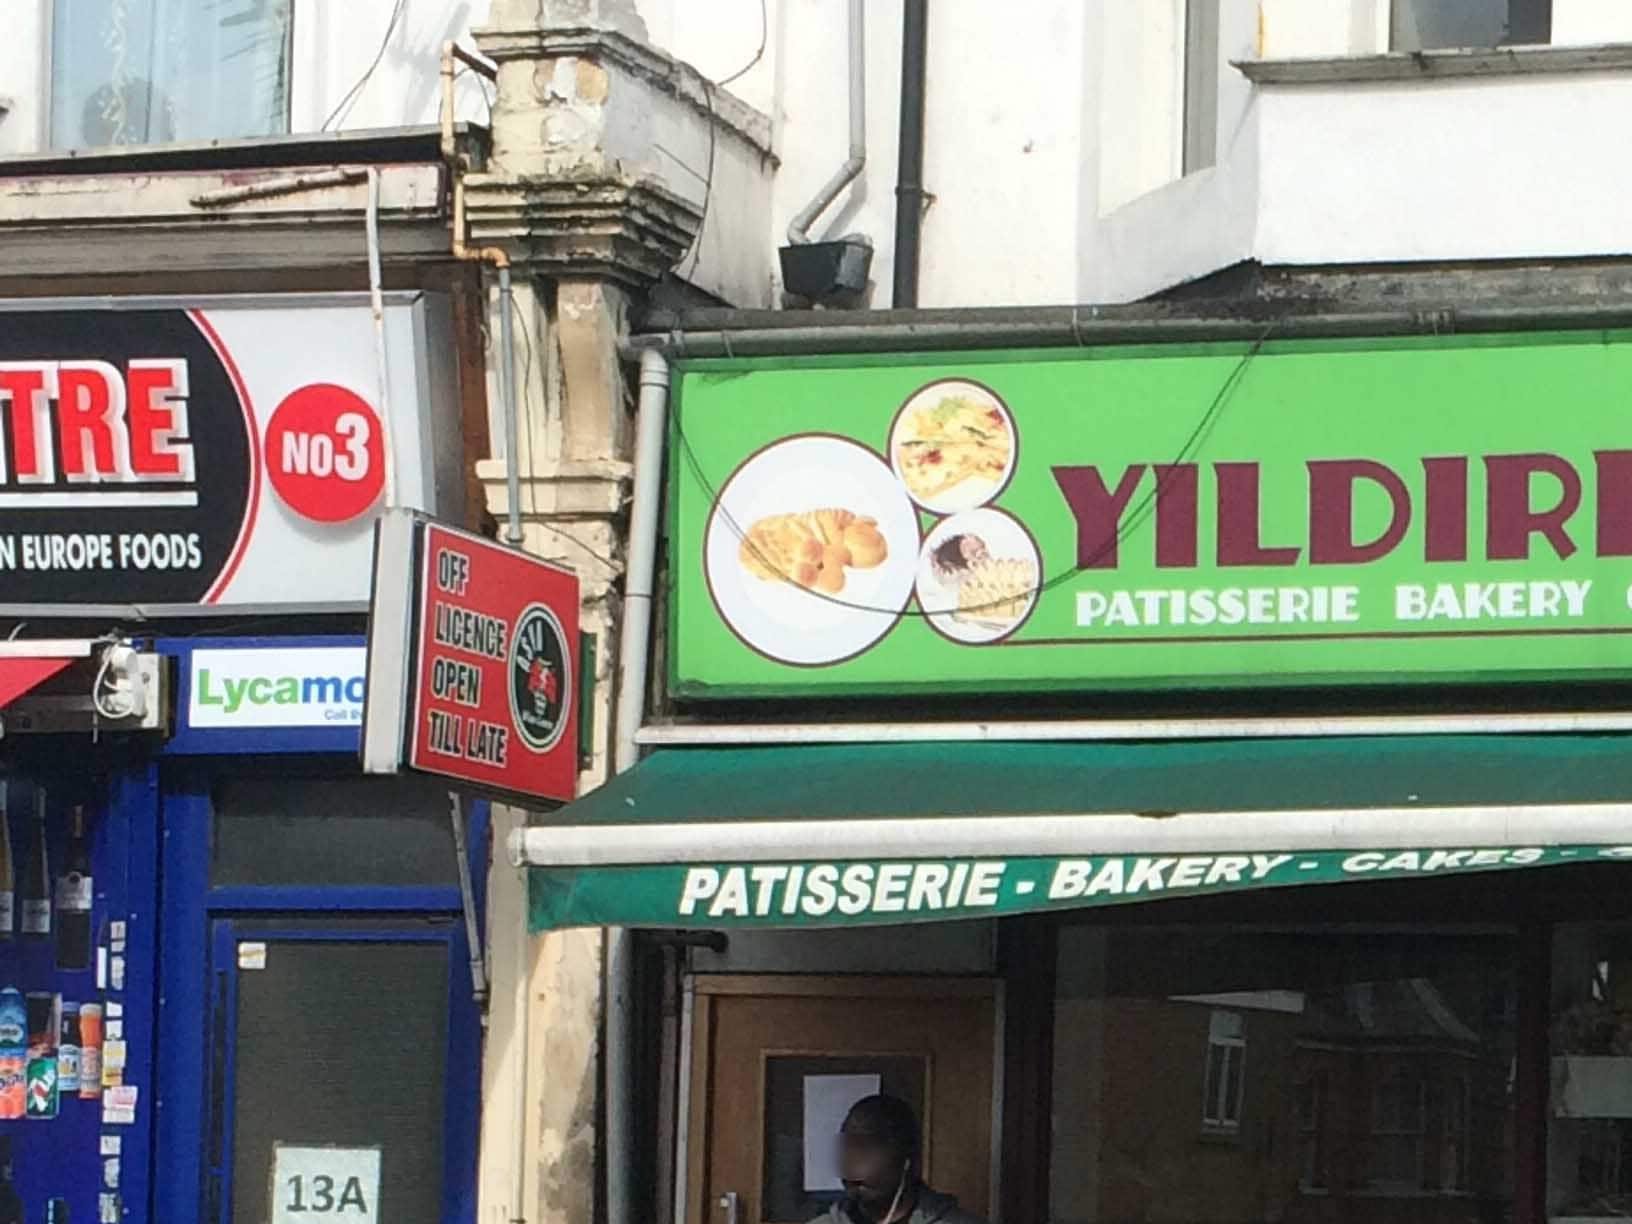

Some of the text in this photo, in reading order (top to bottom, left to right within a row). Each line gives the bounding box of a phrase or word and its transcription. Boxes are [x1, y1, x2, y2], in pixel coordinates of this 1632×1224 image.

[0, 360, 190, 483] TRE
[23, 534, 112, 569] EUROPE
[120, 533, 201, 568] FOODS
[438, 548, 469, 596] OFF
[1076, 585, 1360, 626] PATISSERIE
[1395, 580, 1592, 619] BAKERY
[435, 601, 508, 662] LICENCE
[432, 656, 481, 708] OPEN
[428, 708, 463, 758] TILL
[465, 718, 508, 768] LATE
[679, 848, 1545, 916] PATISSERIE BAKERY CAKES
[286, 1174, 367, 1214] 13A
